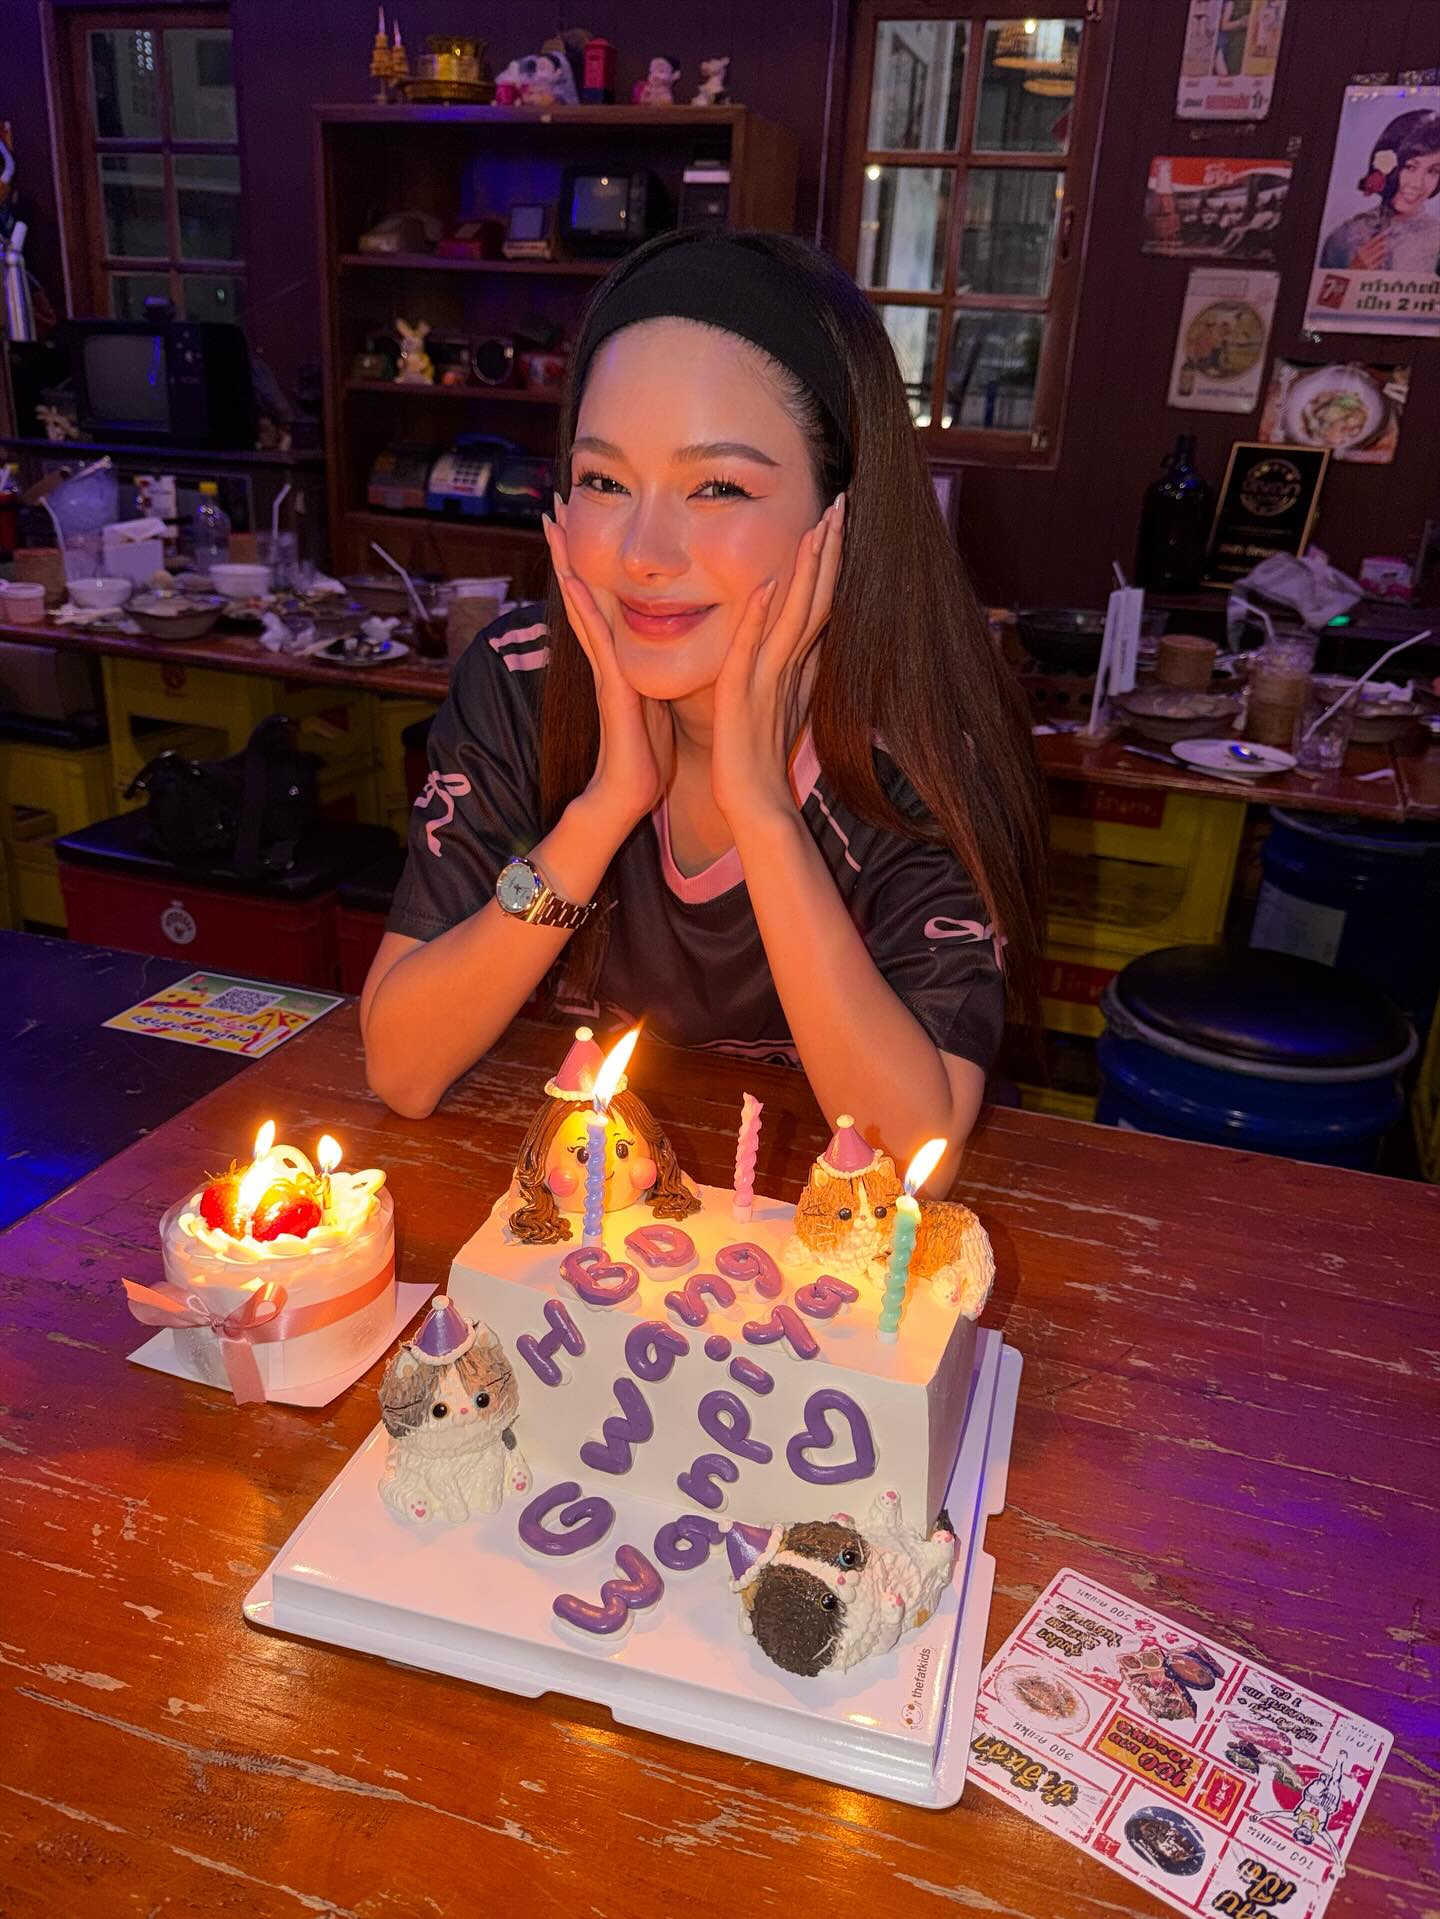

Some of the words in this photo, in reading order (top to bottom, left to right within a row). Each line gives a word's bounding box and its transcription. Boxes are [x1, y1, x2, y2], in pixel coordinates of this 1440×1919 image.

[1397, 297, 1411, 312] 2
[516, 1223, 697, 1387] HBD
[911, 1647, 932, 1699] thefatkids
[1048, 1742, 1074, 1761] 300
[1134, 1748, 1187, 1791] 100
